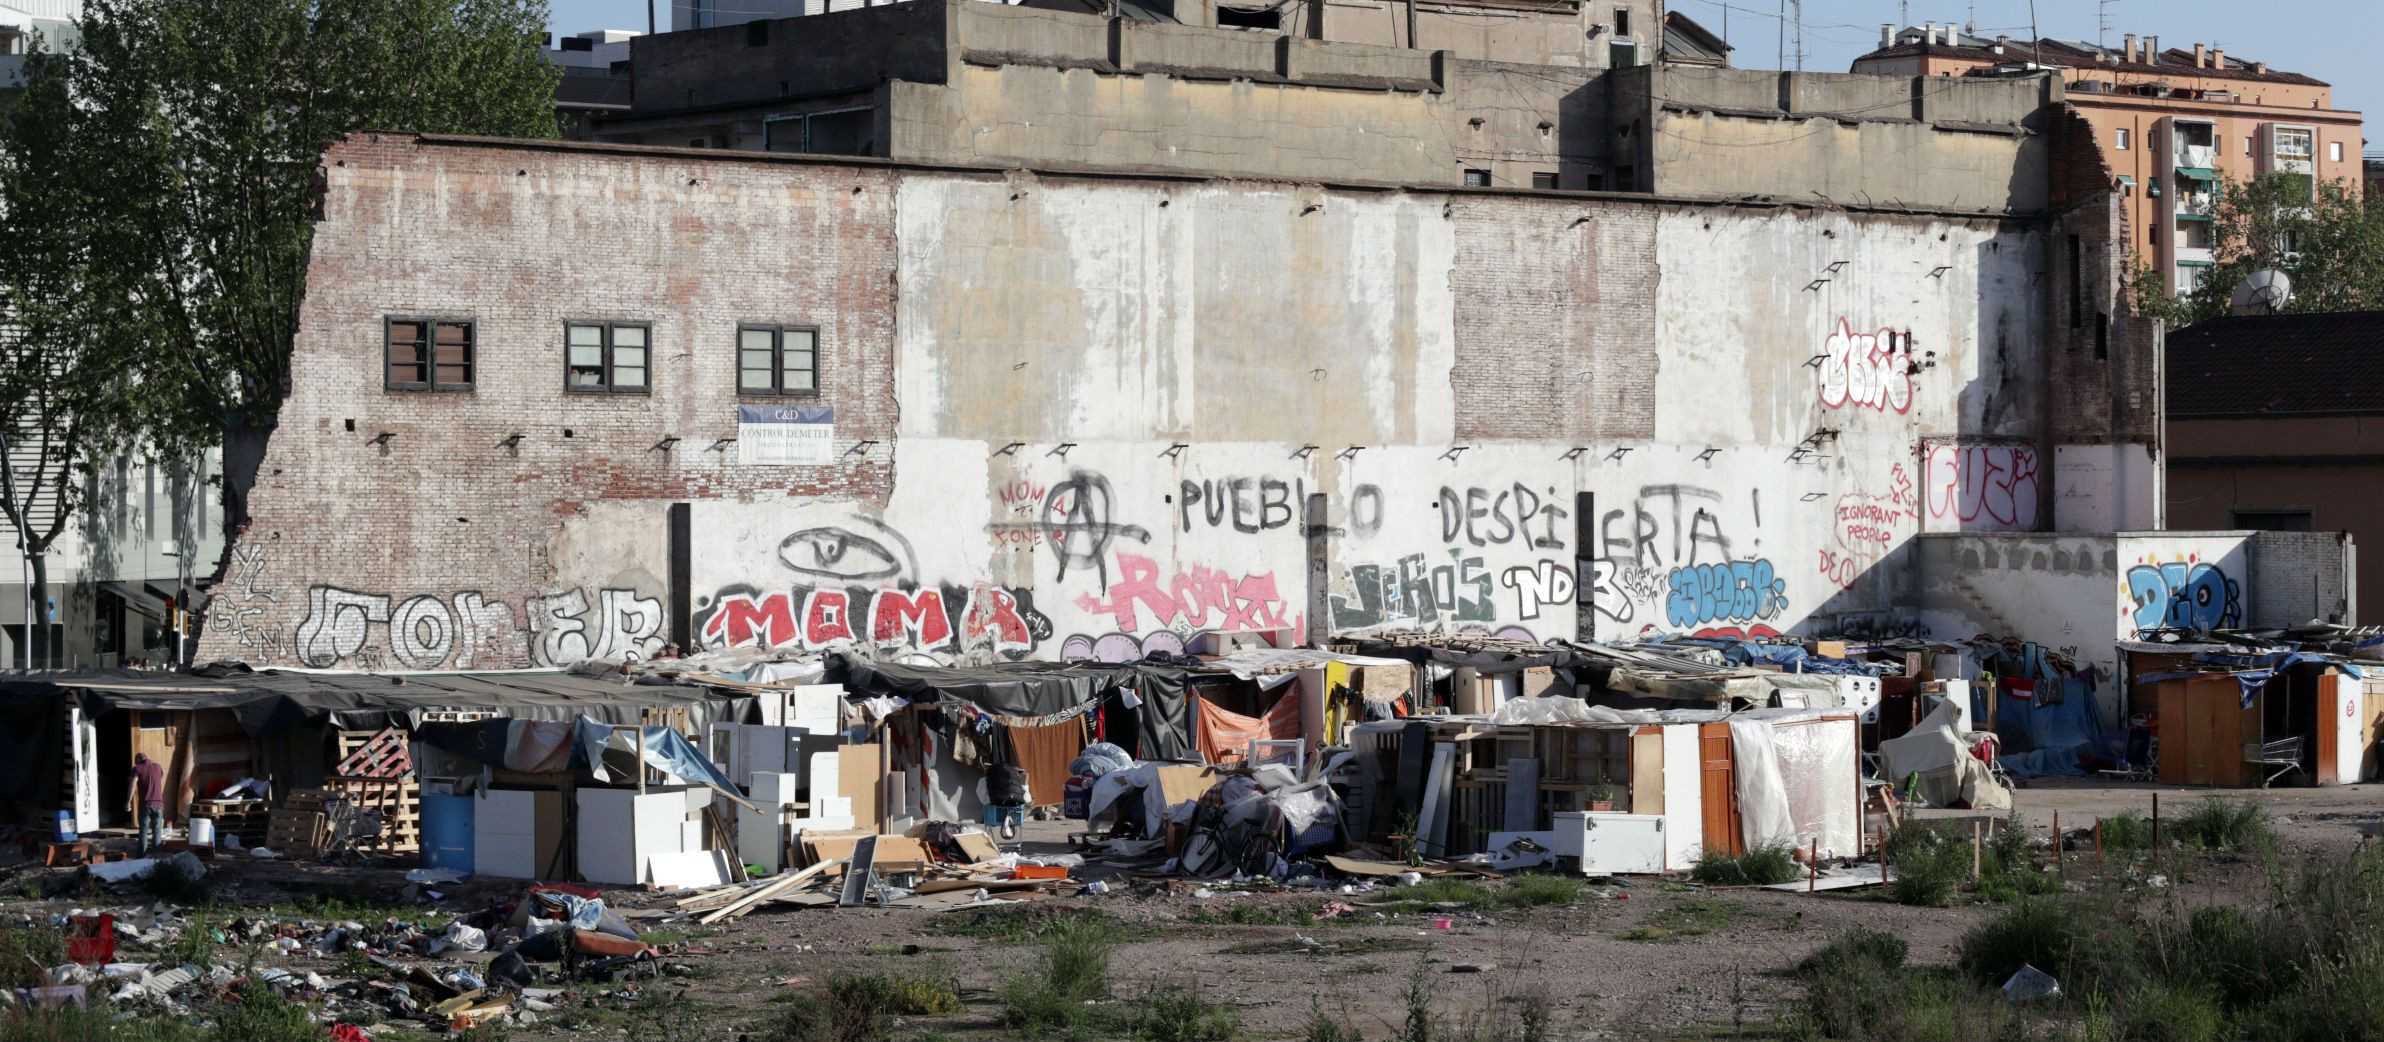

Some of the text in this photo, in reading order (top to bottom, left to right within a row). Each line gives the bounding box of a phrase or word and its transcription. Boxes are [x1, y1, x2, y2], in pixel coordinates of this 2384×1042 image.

[775, 409, 798, 420] C&D
[741, 428, 830, 439] CONTROL DEMETER
[1181, 476, 1384, 534] PUEBLO
[1837, 504, 1901, 527] IGNORANT
